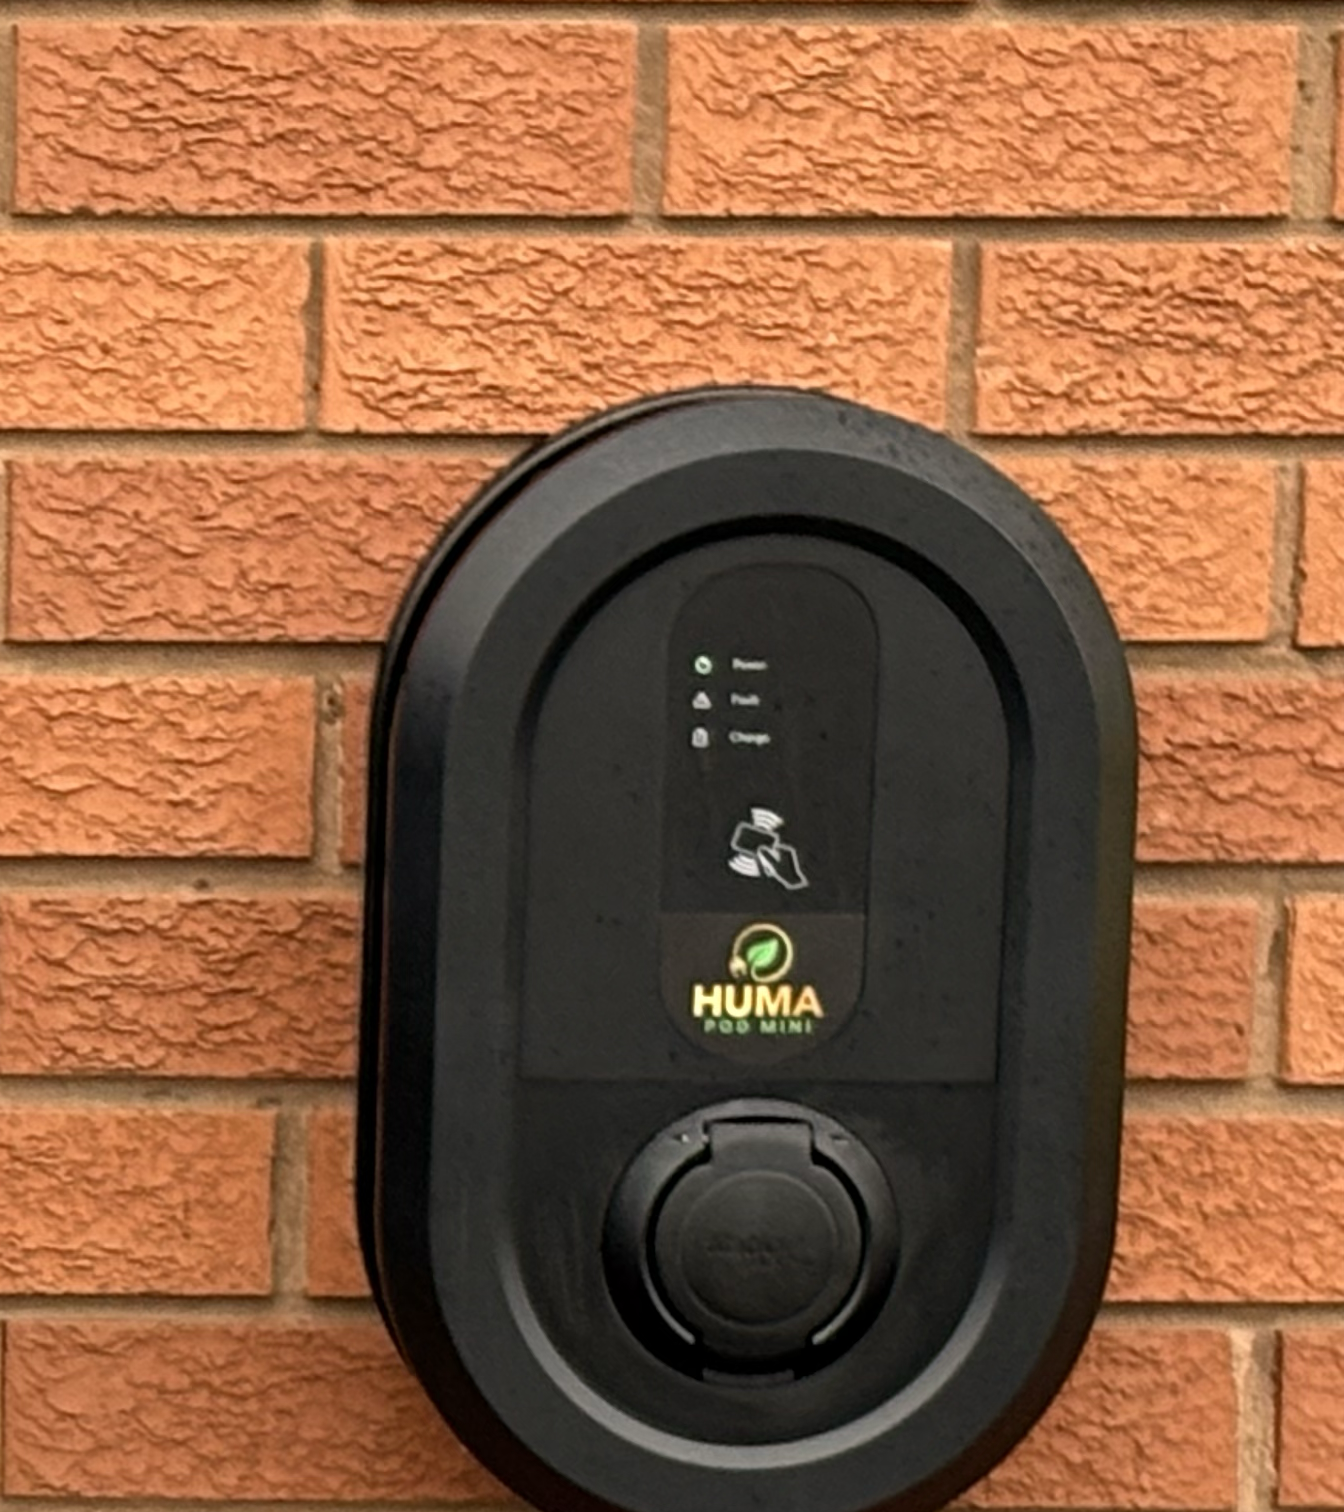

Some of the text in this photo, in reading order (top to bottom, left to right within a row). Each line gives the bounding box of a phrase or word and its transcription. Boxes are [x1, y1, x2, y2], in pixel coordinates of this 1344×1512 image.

[692, 983, 825, 1019] HUMA
[703, 1018, 814, 1035] POD MINI
